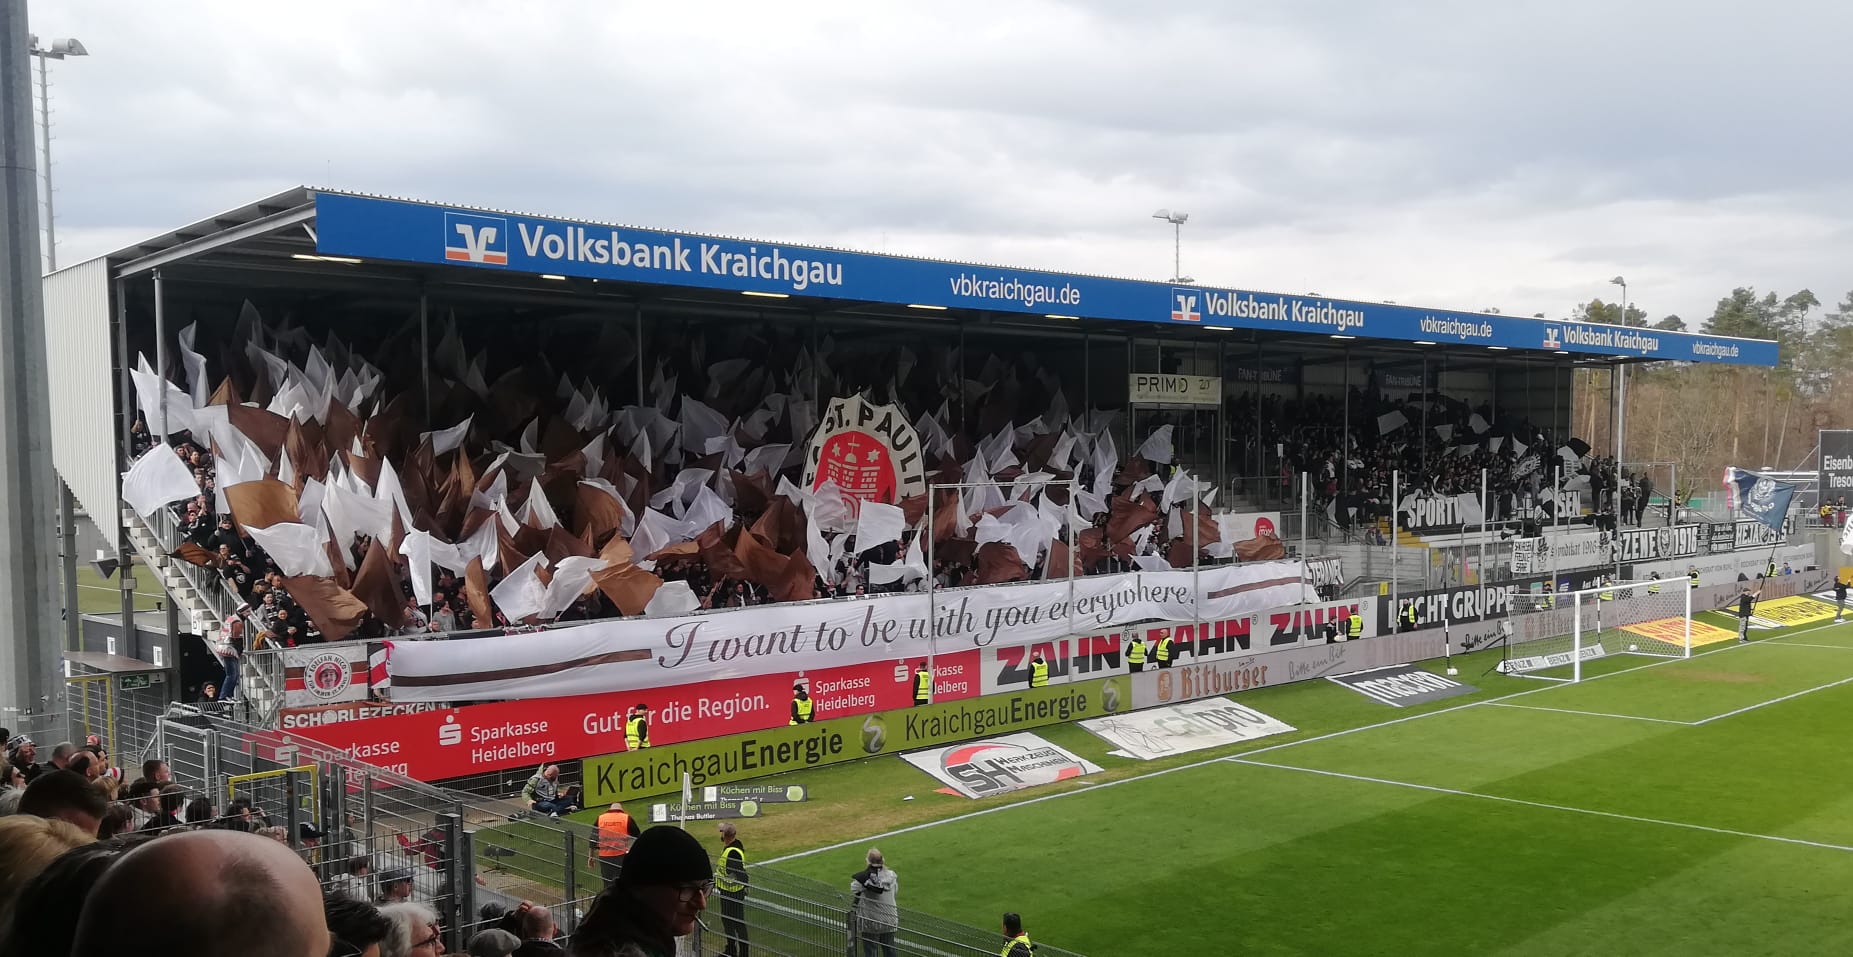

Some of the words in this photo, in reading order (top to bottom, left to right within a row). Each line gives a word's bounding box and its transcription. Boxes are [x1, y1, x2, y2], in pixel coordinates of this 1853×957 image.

[518, 223, 692, 272] Volksbank
[700, 244, 843, 290] Kraichgau
[950, 272, 1081, 306] vbkraichgau.de
[1205, 292, 1289, 321] Volksbank
[1291, 300, 1364, 332] Kraichgau
[1419, 316, 1492, 340] vbkraichgau.de
[1563, 325, 1613, 349] Volksbank
[1614, 332, 1659, 355] Kraichgau
[1692, 342, 1739, 360] vbkraichgau.de
[858, 401, 922, 485] PAULI
[1613, 530, 1657, 562] SZENE
[1735, 523, 1759, 546] HEJA
[1452, 585, 1515, 619] GRUPPE
[658, 619, 709, 668] I
[708, 625, 804, 661] want
[815, 625, 855, 652] to
[860, 604, 900, 646] be
[909, 597, 975, 640] with
[974, 603, 1043, 647] you
[1048, 574, 1195, 624] everywhere.
[1146, 617, 1251, 664] ZAHN
[1578, 647, 1593, 659] ENZ
[996, 633, 1121, 687] ZAHN
[1288, 661, 1311, 680] Bitte
[1328, 645, 1346, 662] Bit
[815, 674, 871, 695] Sparkasse
[1180, 662, 1269, 700] Bitburger
[583, 711, 621, 734] Gut
[660, 702, 690, 724] die
[698, 692, 770, 722] Region.
[815, 692, 876, 712] Heidelberg
[906, 692, 1088, 741] KraichgauEnergie
[471, 719, 549, 744] Sparkasse
[472, 740, 556, 765] Heidelberg
[597, 728, 844, 798] KraichgauEnergie
[752, 785, 766, 793] mit
[767, 784, 784, 794] Biss
[947, 759, 1025, 793] SH
[670, 803, 701, 812] Kühen
[720, 801, 737, 810] Biss
